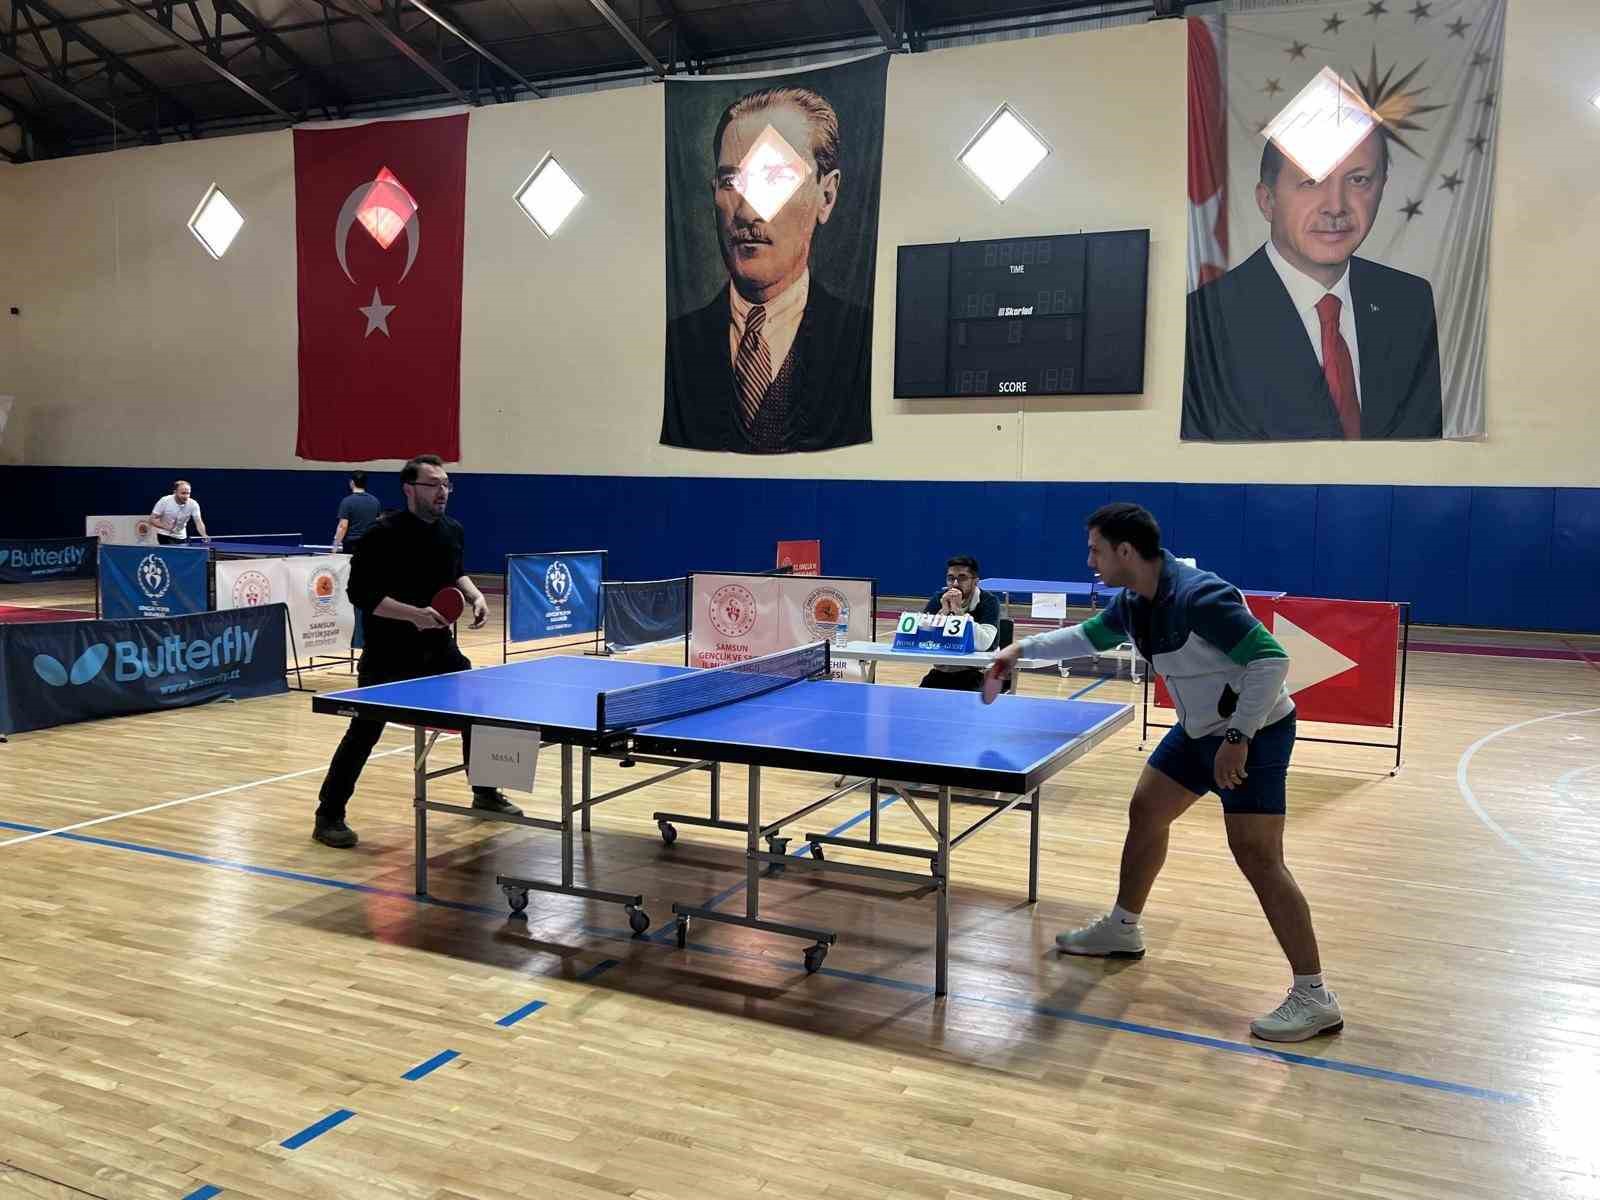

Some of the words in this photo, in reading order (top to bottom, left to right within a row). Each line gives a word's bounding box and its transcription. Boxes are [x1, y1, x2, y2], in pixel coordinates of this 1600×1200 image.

[1009, 265, 1025, 273] TIME
[998, 381, 1027, 393] SCORE
[11, 545, 86, 568] Butterfly
[901, 616, 915, 633] 0
[948, 619, 962, 635] 3
[114, 625, 260, 683] Butterfly
[715, 642, 749, 652] SAMSUN
